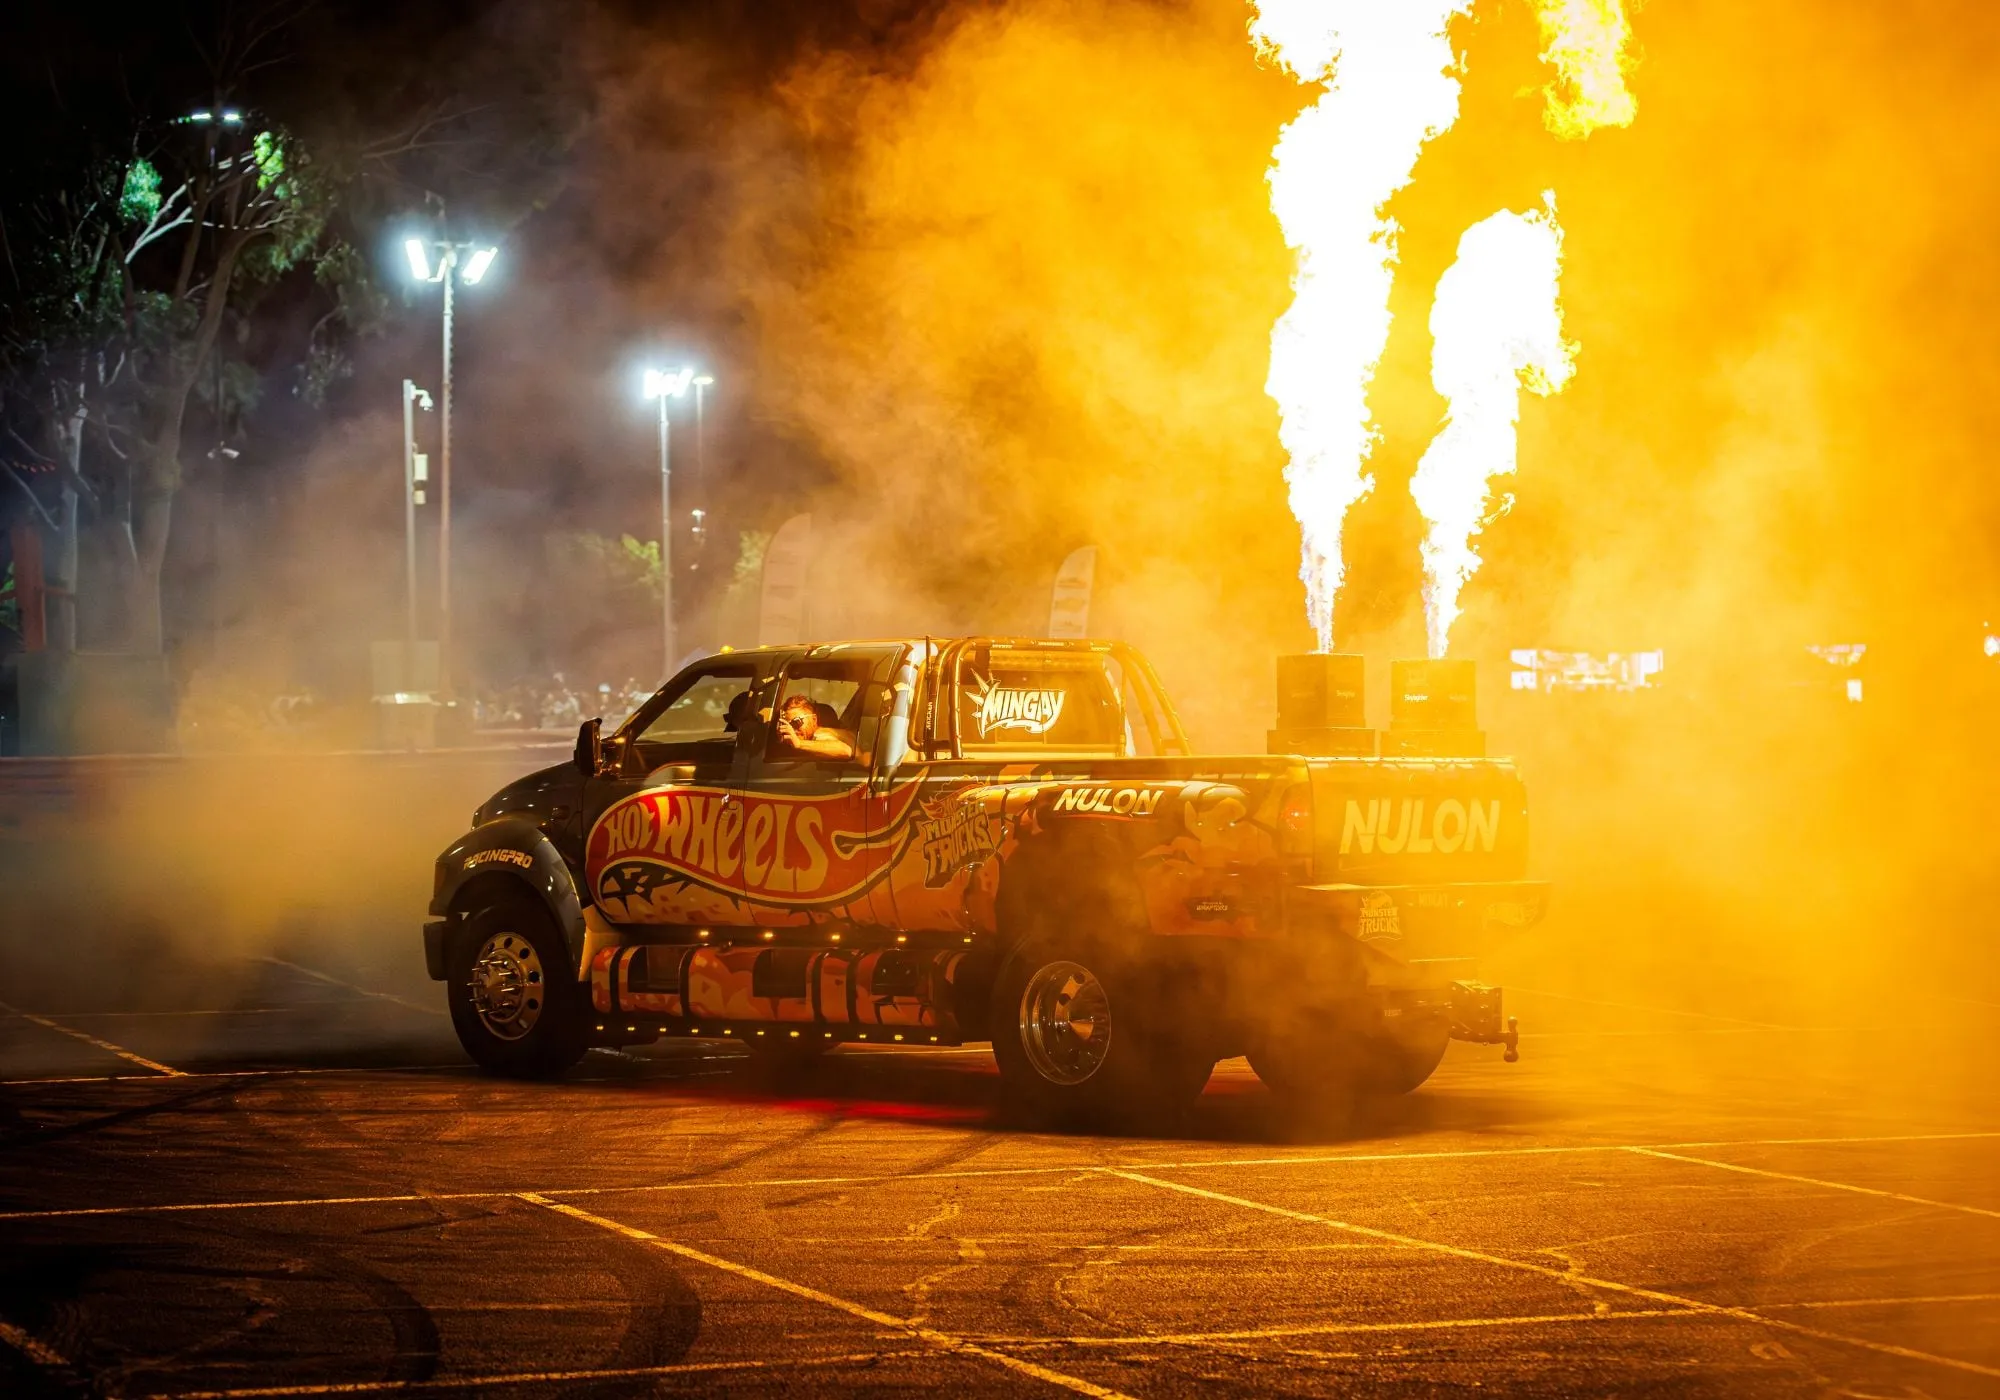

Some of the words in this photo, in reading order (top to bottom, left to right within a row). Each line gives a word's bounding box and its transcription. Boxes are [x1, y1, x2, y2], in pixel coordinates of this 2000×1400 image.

[980, 680, 1066, 739] MINGAY
[1053, 788, 1165, 815] NULON
[1338, 798, 1500, 854] NULON
[604, 802, 655, 860] HOT
[924, 813, 994, 882] TRUCKS
